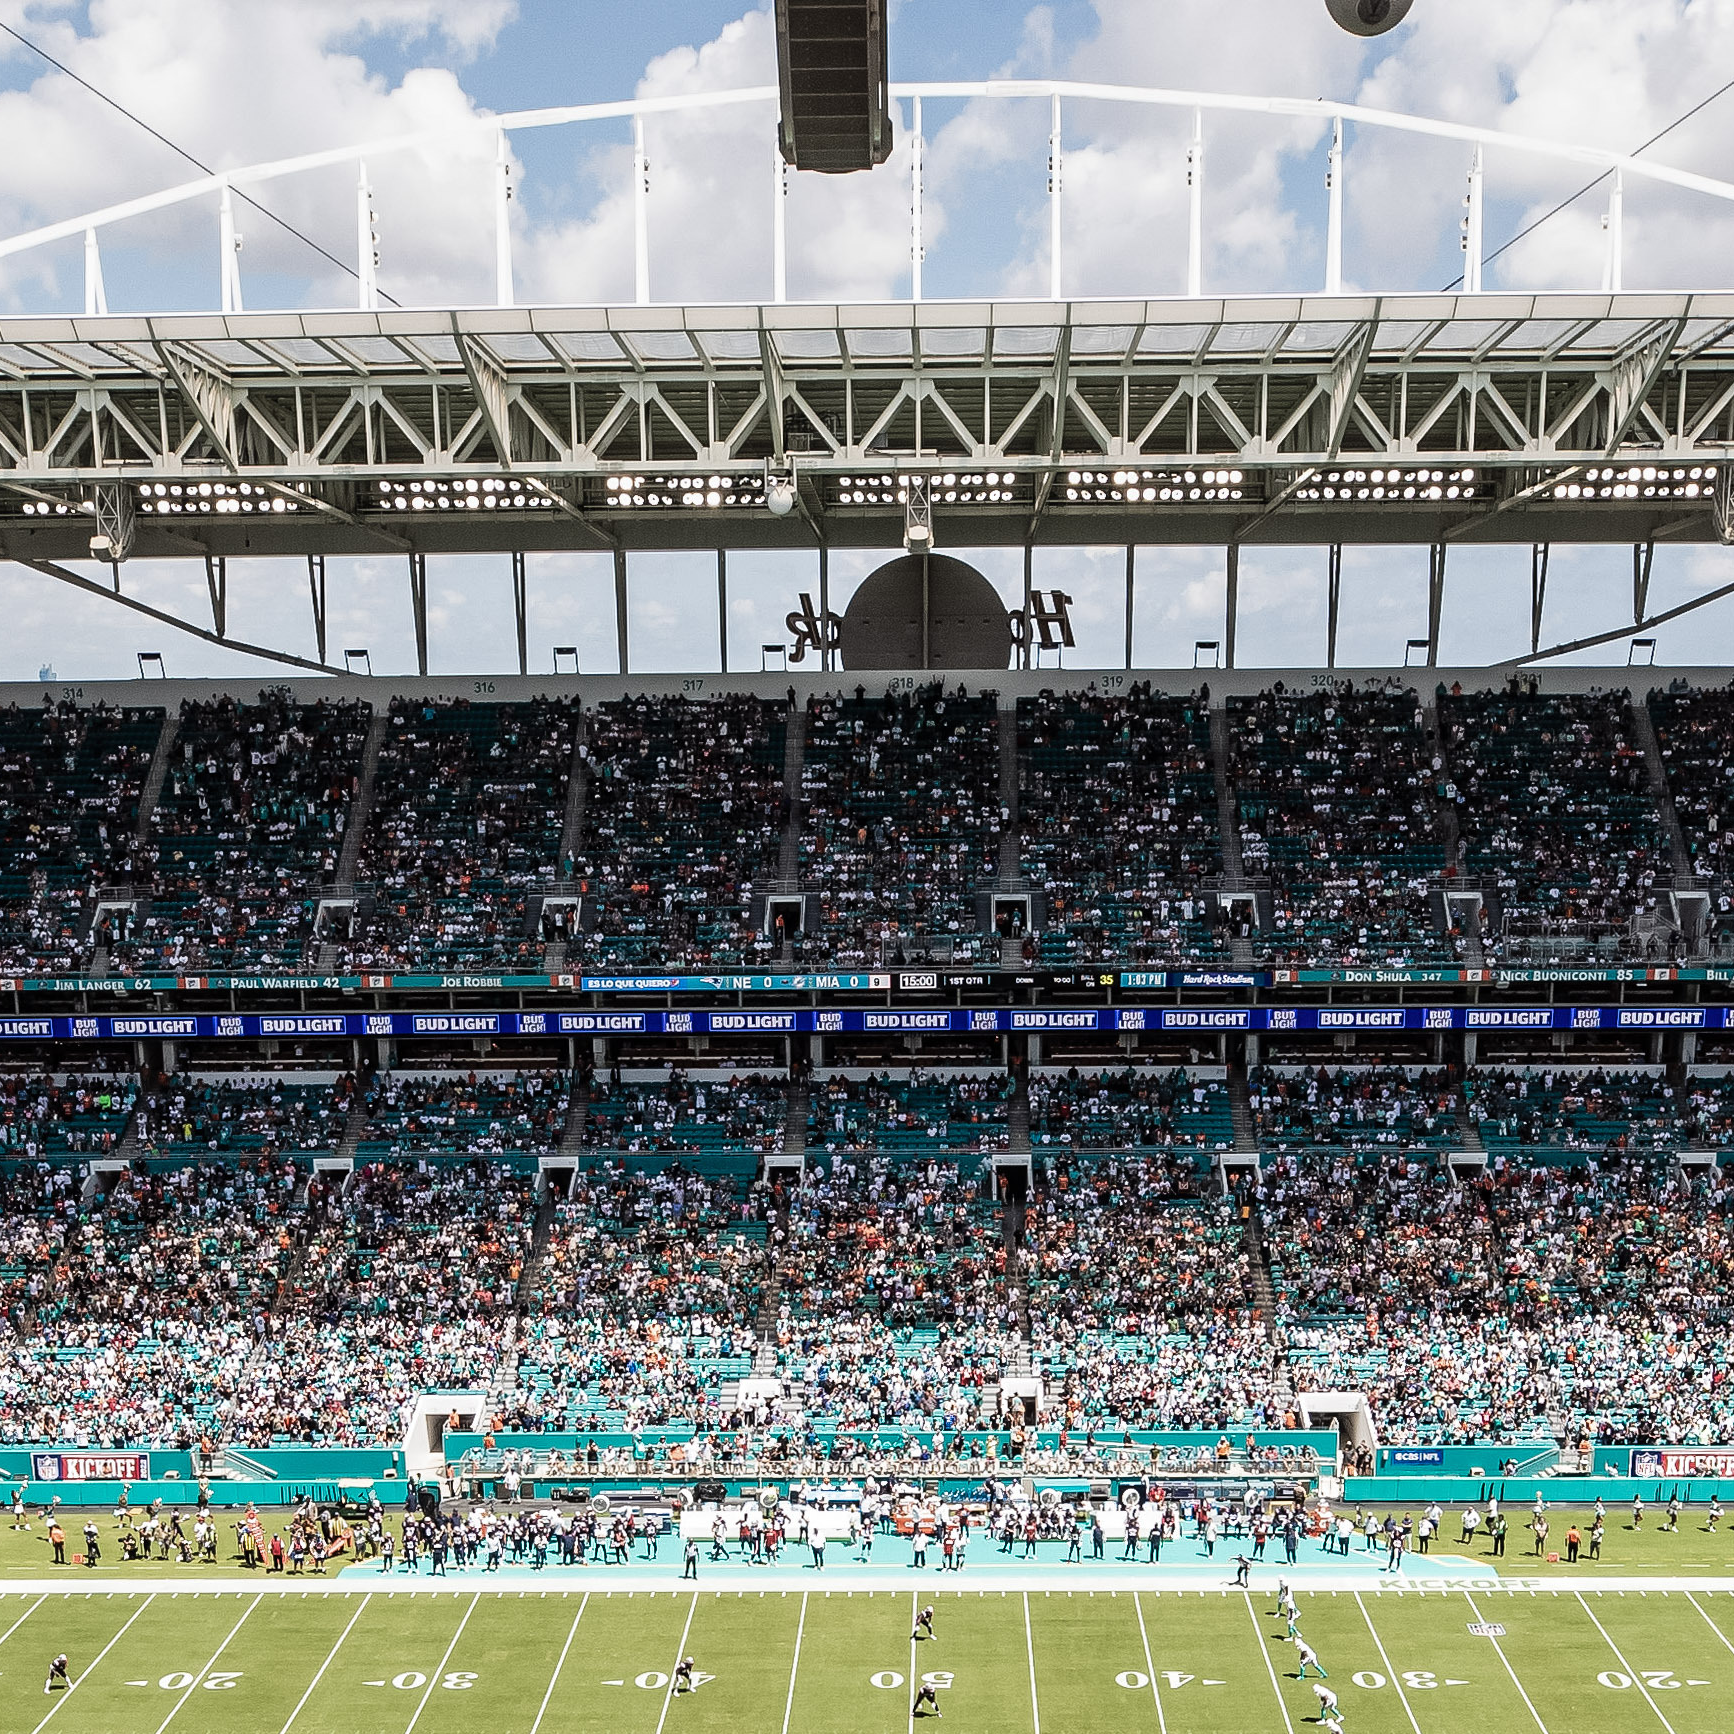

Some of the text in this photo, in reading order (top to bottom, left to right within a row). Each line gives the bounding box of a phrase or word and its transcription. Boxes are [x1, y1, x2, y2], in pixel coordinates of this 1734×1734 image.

[891, 677, 914, 689] 318
[1100, 676, 1123, 687] 319
[1310, 675, 1334, 687] 320
[902, 975, 934, 986] 15:00
[1345, 971, 1442, 982] DON SHULA 347
[1500, 970, 1633, 981] NICK BUONICONTI 85
[1706, 970, 1729, 980] BILL
[53, 979, 152, 991] JIM LANGER 62
[230, 977, 340, 989] PAUL WARFIELD 42
[441, 977, 503, 988] JOE ROBBIE
[733, 977, 772, 989] NE 0
[816, 976, 859, 987] MIA 0
[713, 1015, 792, 1028] BUD LIGHT
[1165, 1013, 1244, 1025] BUD LIGHT
[1620, 1011, 1703, 1024] BUD LIGHT
[263, 1018, 342, 1032] BUD LIGHT
[1378, 1579, 1541, 1589] KICKOFF
